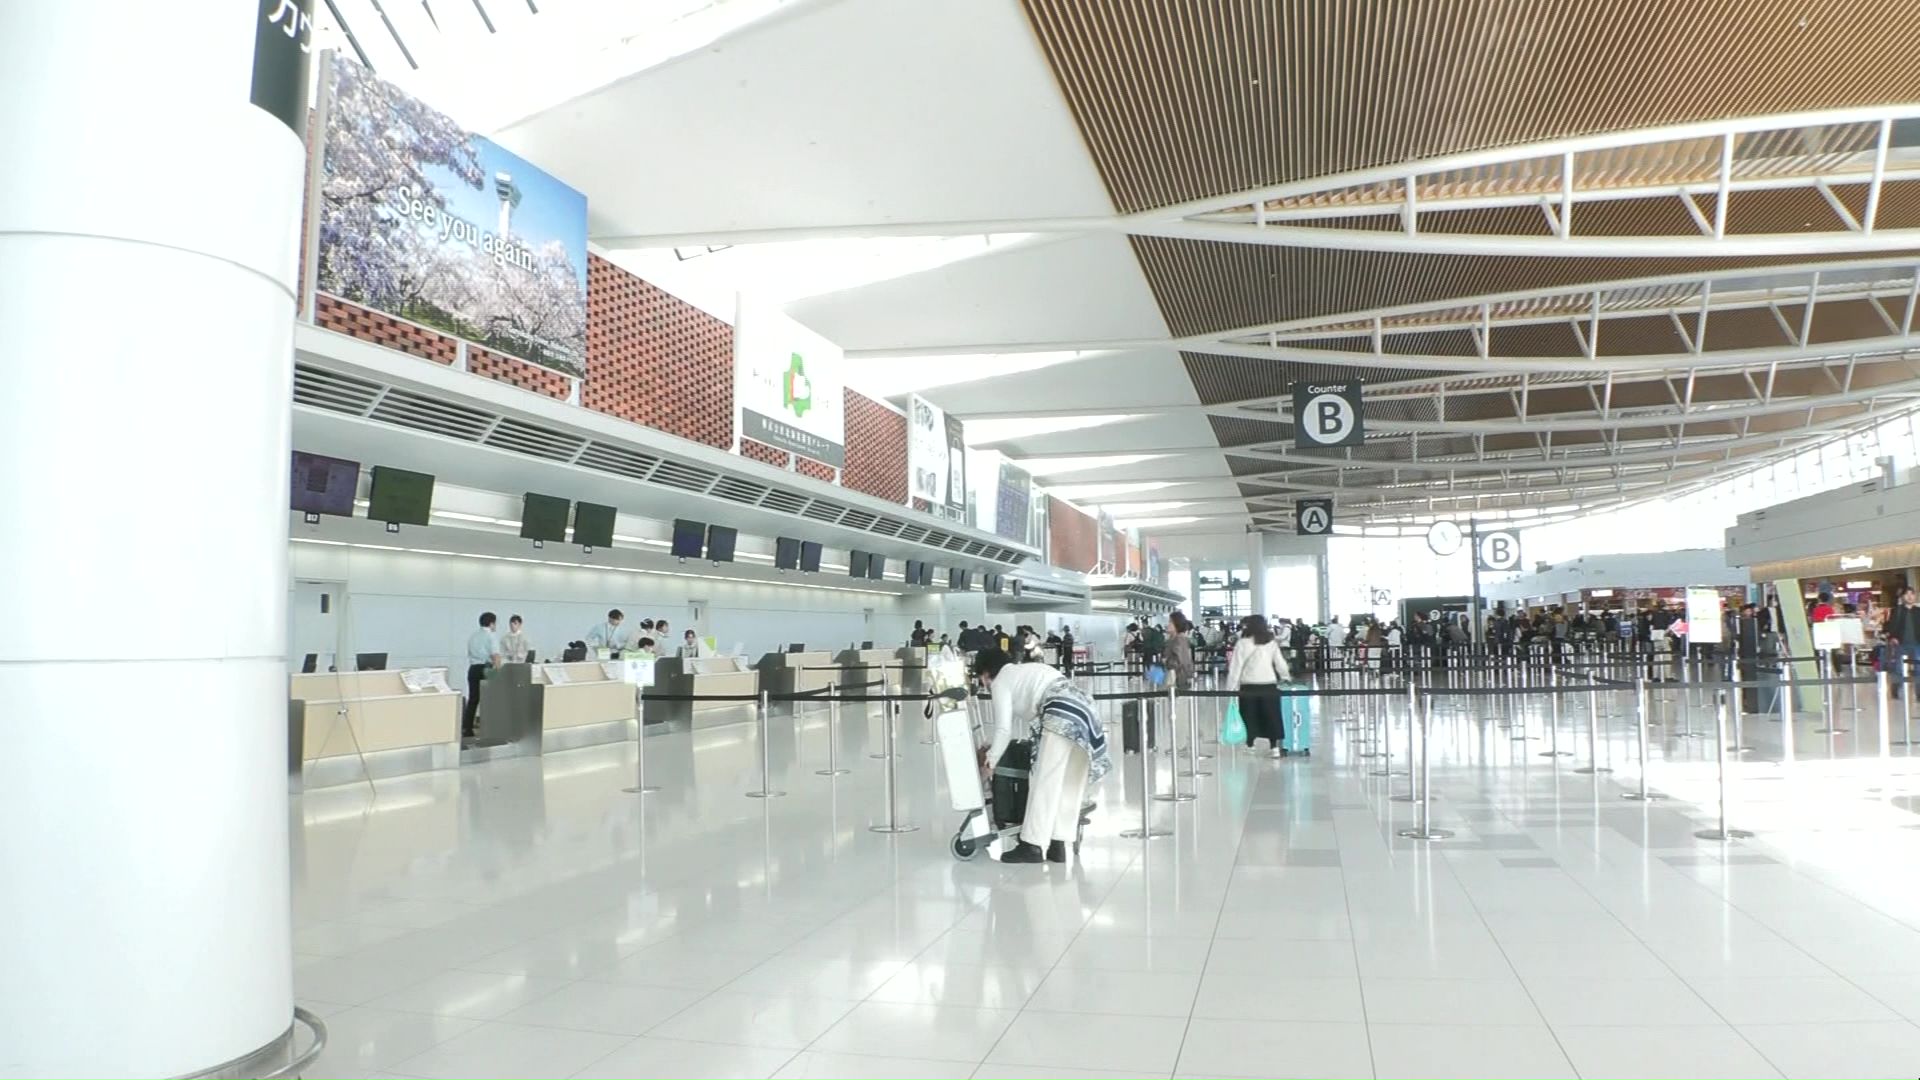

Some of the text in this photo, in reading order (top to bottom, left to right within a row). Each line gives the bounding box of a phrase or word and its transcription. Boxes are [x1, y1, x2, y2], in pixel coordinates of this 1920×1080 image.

[398, 186, 537, 273] See you again.
[1307, 384, 1348, 394] Counter
[1317, 401, 1344, 435] B
[1306, 510, 1324, 528] A
[1491, 537, 1511, 564] B
[1377, 591, 1388, 602] A
